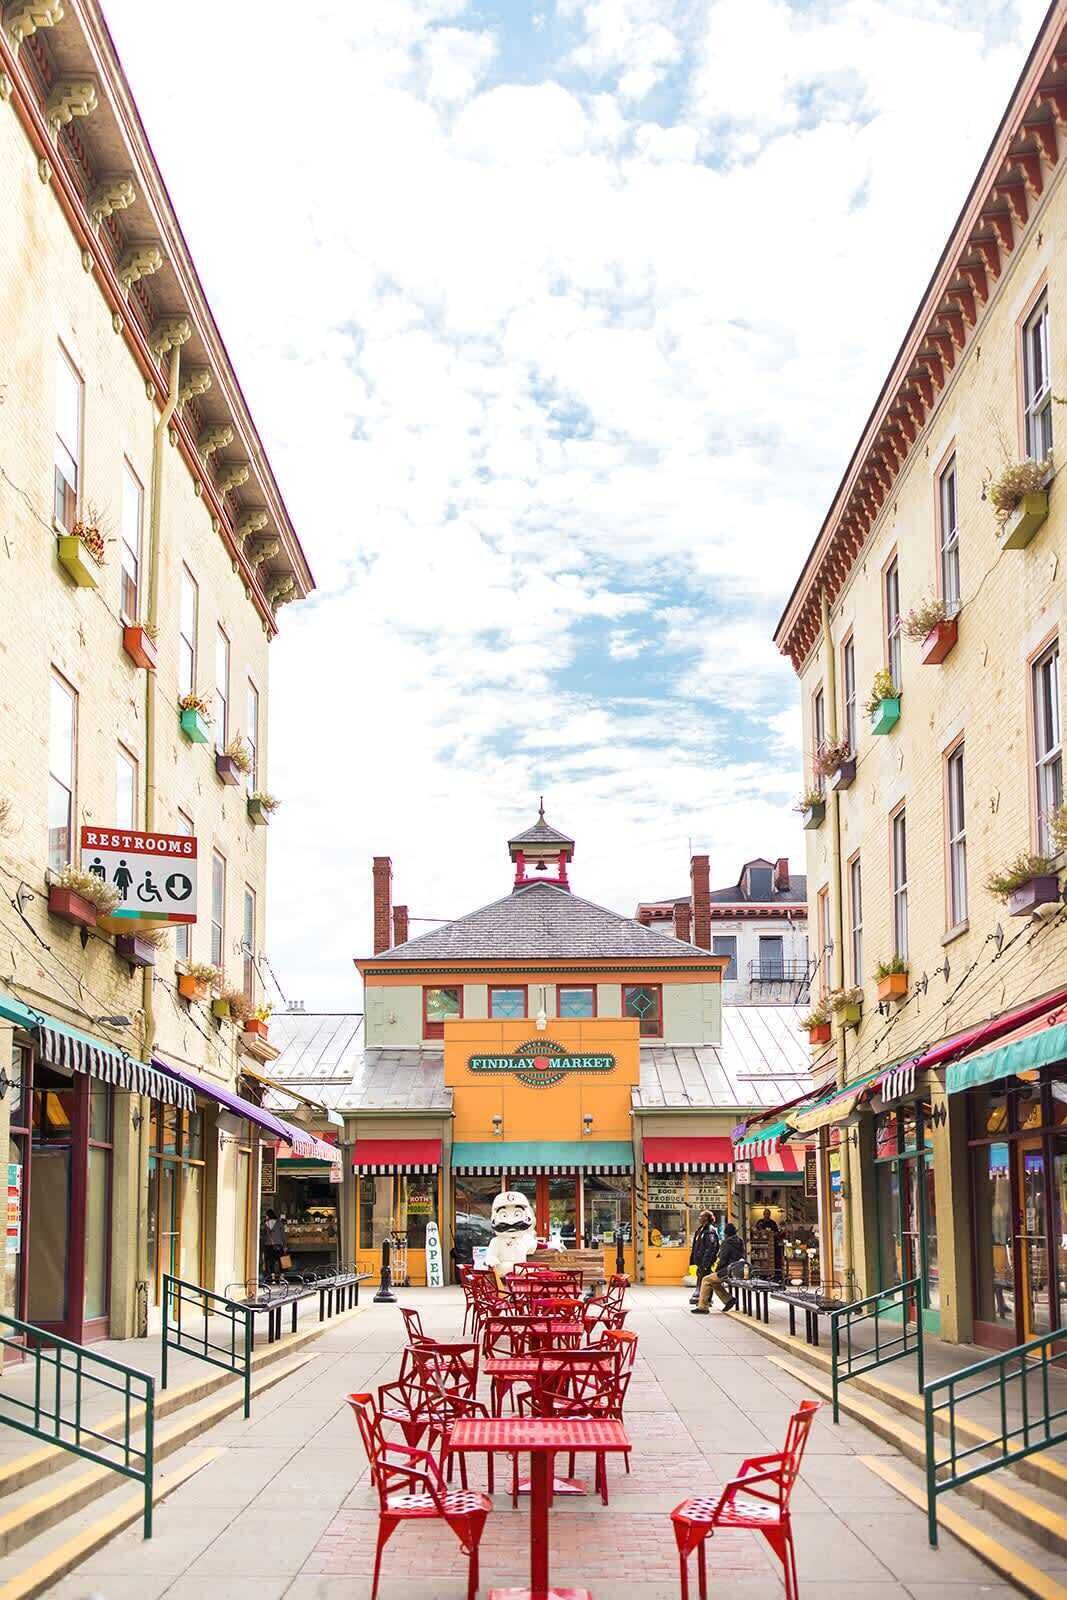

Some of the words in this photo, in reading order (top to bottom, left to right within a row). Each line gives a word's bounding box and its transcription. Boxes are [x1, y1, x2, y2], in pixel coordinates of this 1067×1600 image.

[86, 832, 192, 854] RESTROOMS
[520, 1041, 541, 1053] SINCE
[471, 1058, 535, 1069] FINDLAY
[549, 1057, 613, 1069] MARKET
[428, 1237, 440, 1286] OPEN
